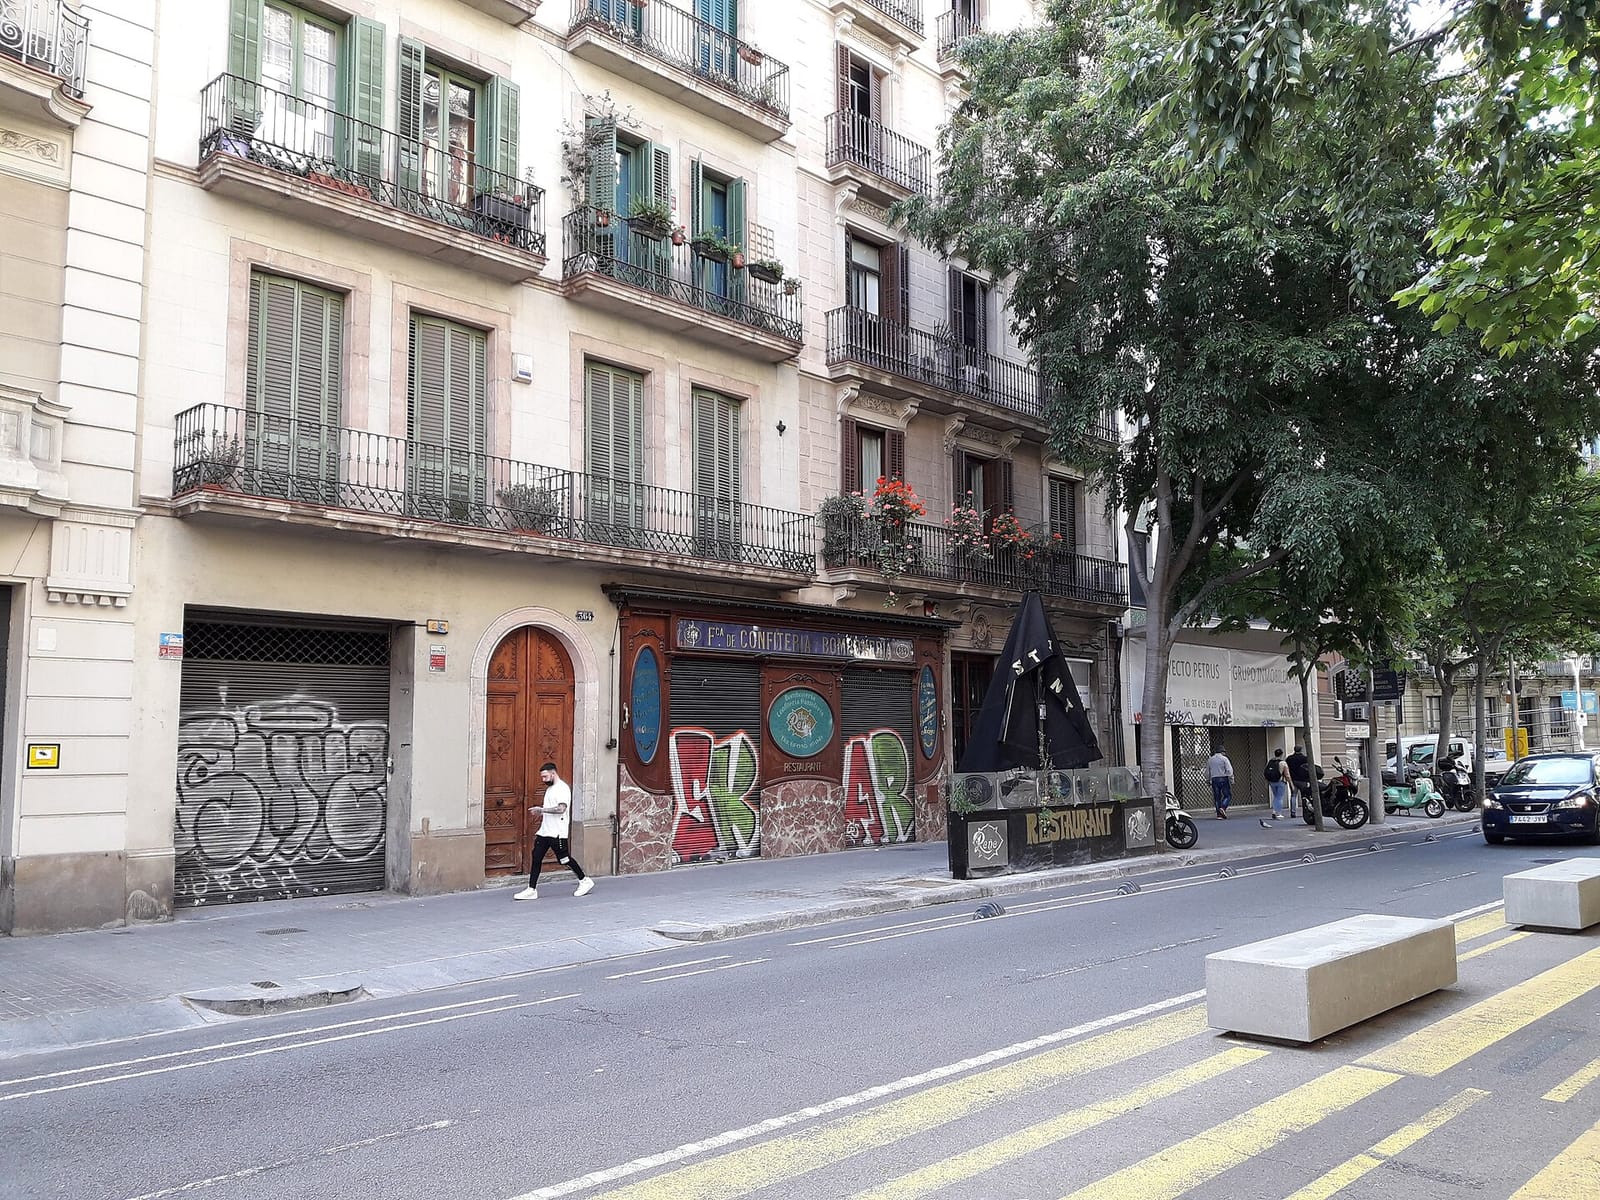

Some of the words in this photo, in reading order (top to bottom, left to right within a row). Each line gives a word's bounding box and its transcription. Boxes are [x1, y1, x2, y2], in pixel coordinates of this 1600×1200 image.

[726, 634, 736, 648] DE
[740, 629, 811, 654] CONFITERIA
[1193, 662, 1220, 679] PETRUS
[1232, 665, 1256, 682] GRUPO
